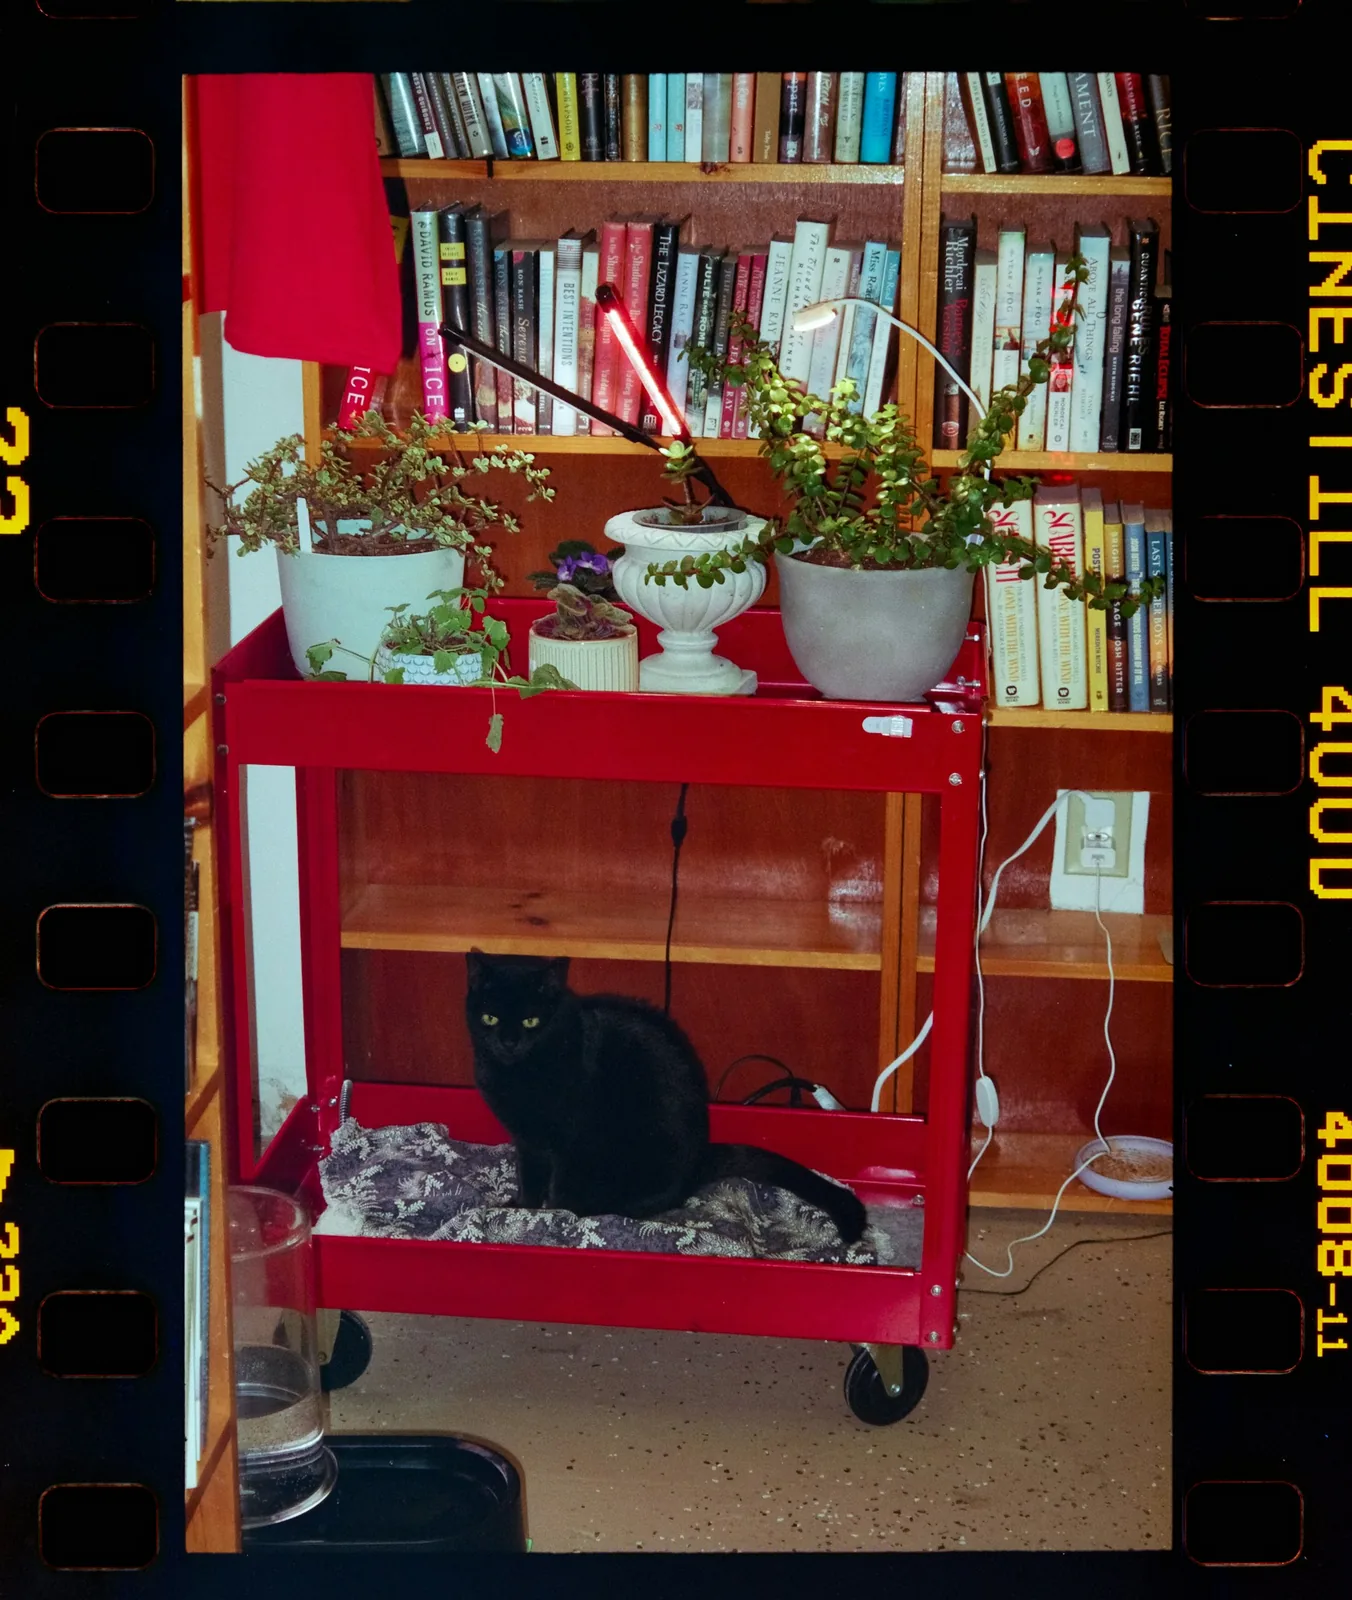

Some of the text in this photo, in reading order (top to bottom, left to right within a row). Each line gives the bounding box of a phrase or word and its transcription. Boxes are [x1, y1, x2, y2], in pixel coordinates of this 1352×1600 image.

[461, 101, 477, 128] QUIRK
[808, 233, 820, 252] The
[419, 231, 435, 317] DAVID RAMUS
[475, 259, 485, 297] RASH
[606, 255, 619, 283] Shado
[631, 255, 644, 290] Shadow
[803, 257, 817, 290] Cloud
[868, 249, 881, 272] Miss
[944, 241, 958, 294] Richler
[955, 236, 969, 291] Mordecai
[1138, 252, 1150, 304] QUANTICO
[651, 235, 671, 344] THE LAZARD LEGACY
[680, 260, 692, 298] JEANNE
[702, 262, 713, 298] JULIE
[722, 267, 732, 292] JULIE
[767, 253, 786, 335] JEANNE RAY
[864, 275, 878, 299] Read
[884, 262, 897, 301] Miss Read
[1035, 275, 1043, 296] YEAR
[1114, 287, 1125, 303] the
[497, 291, 507, 321] RASH
[517, 268, 531, 364] RON RASH Serena
[1005, 291, 1014, 313] FOG
[1033, 305, 1042, 327] FOG
[1085, 256, 1099, 361] ABOVE ALL THINGS
[1110, 304, 1124, 325] long
[560, 282, 575, 367] BEST INTENTIONS
[697, 315, 707, 348] ROME
[718, 309, 727, 338] ROMEO
[942, 303, 956, 354] Version
[954, 299, 968, 356] Barney's
[1109, 326, 1123, 353] falling
[1126, 298, 1142, 407] GENE RIEHL
[1158, 326, 1171, 357] TOTAL
[424, 327, 444, 406] ON ICE
[1155, 359, 1169, 400] ECLIPSE
[347, 365, 371, 406] ICE
[725, 390, 734, 411] RAY
[1058, 397, 1066, 430] MORDECAI
[1151, 540, 1161, 567] LAST
[1110, 531, 1124, 694] BRIGHT'S JOSH RITTER
[1003, 585, 1021, 683] GONE WITH THE WIND
[1153, 617, 1163, 646] BOYS
[1058, 615, 1072, 685] WITH THE WIND
